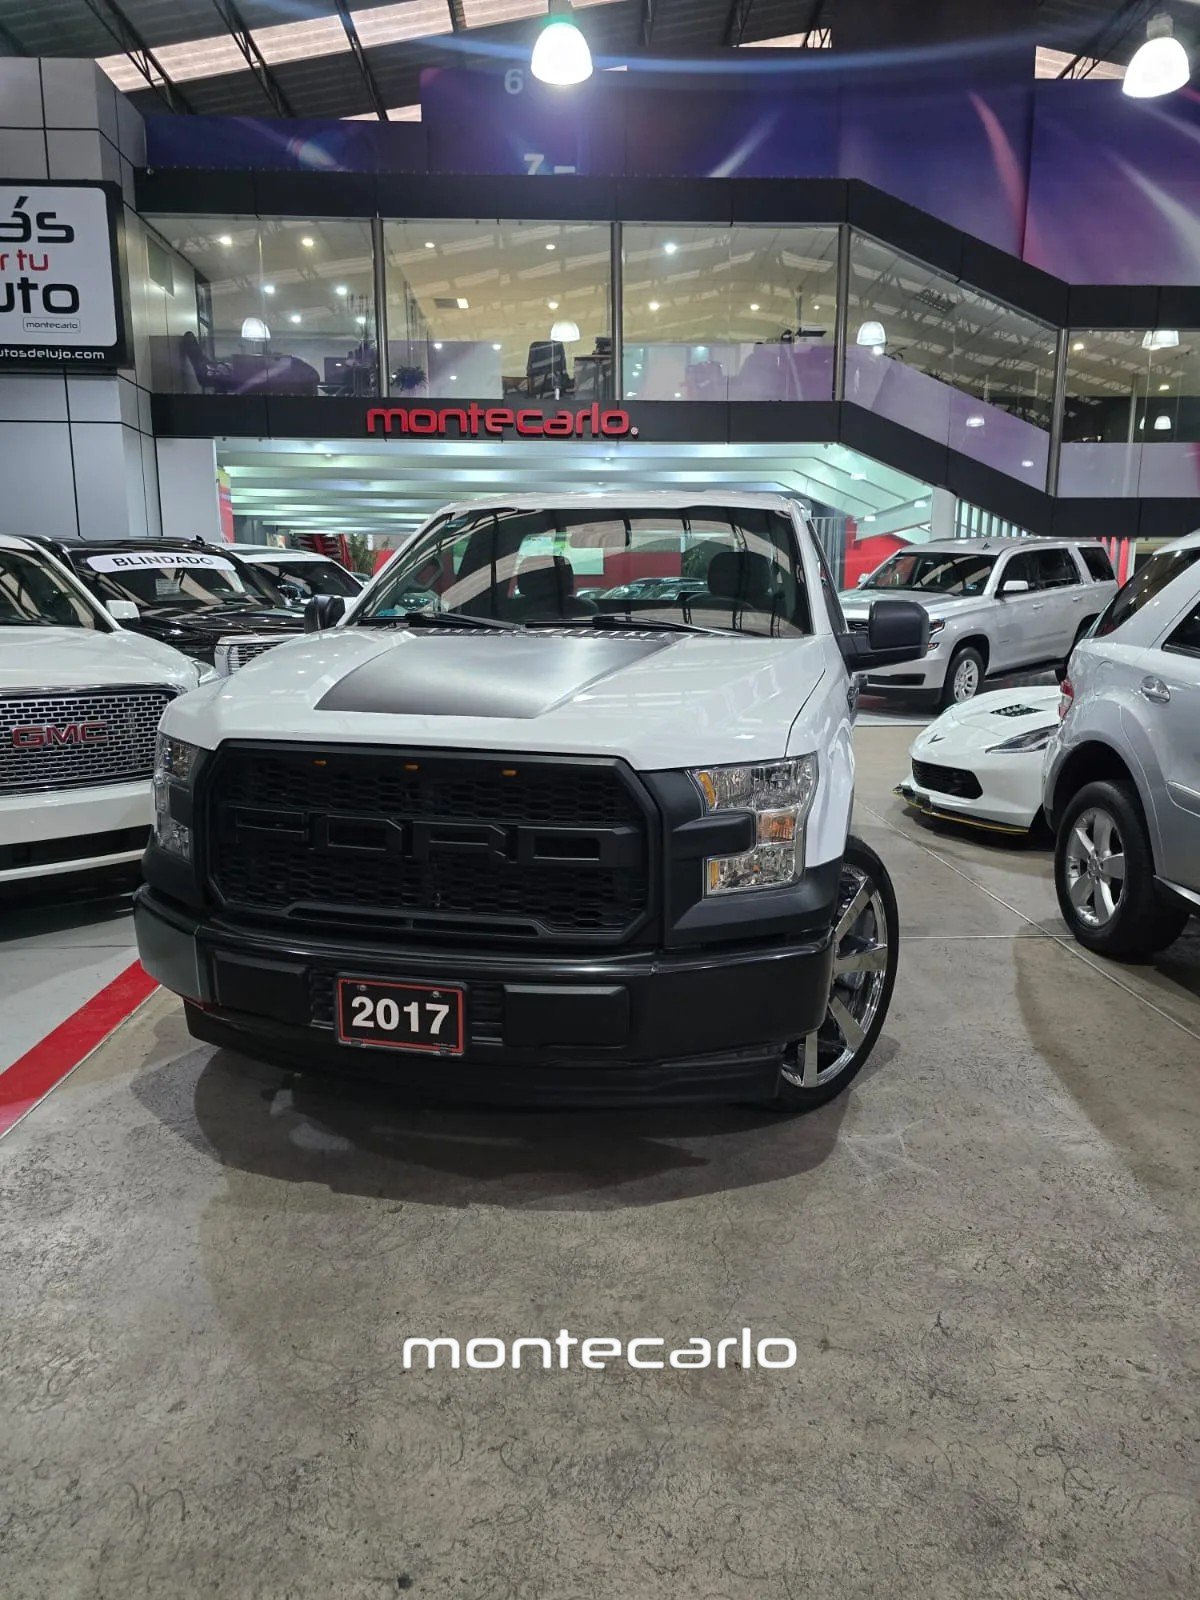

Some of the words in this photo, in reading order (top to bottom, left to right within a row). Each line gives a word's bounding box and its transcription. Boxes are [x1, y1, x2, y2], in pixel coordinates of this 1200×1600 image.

[504, 68, 524, 95] 6
[17, 249, 49, 271] tu
[26, 321, 78, 329] montecarlo
[112, 555, 214, 567] BLINDADO
[12, 721, 108, 748] GMC
[351, 996, 450, 1035] 2017
